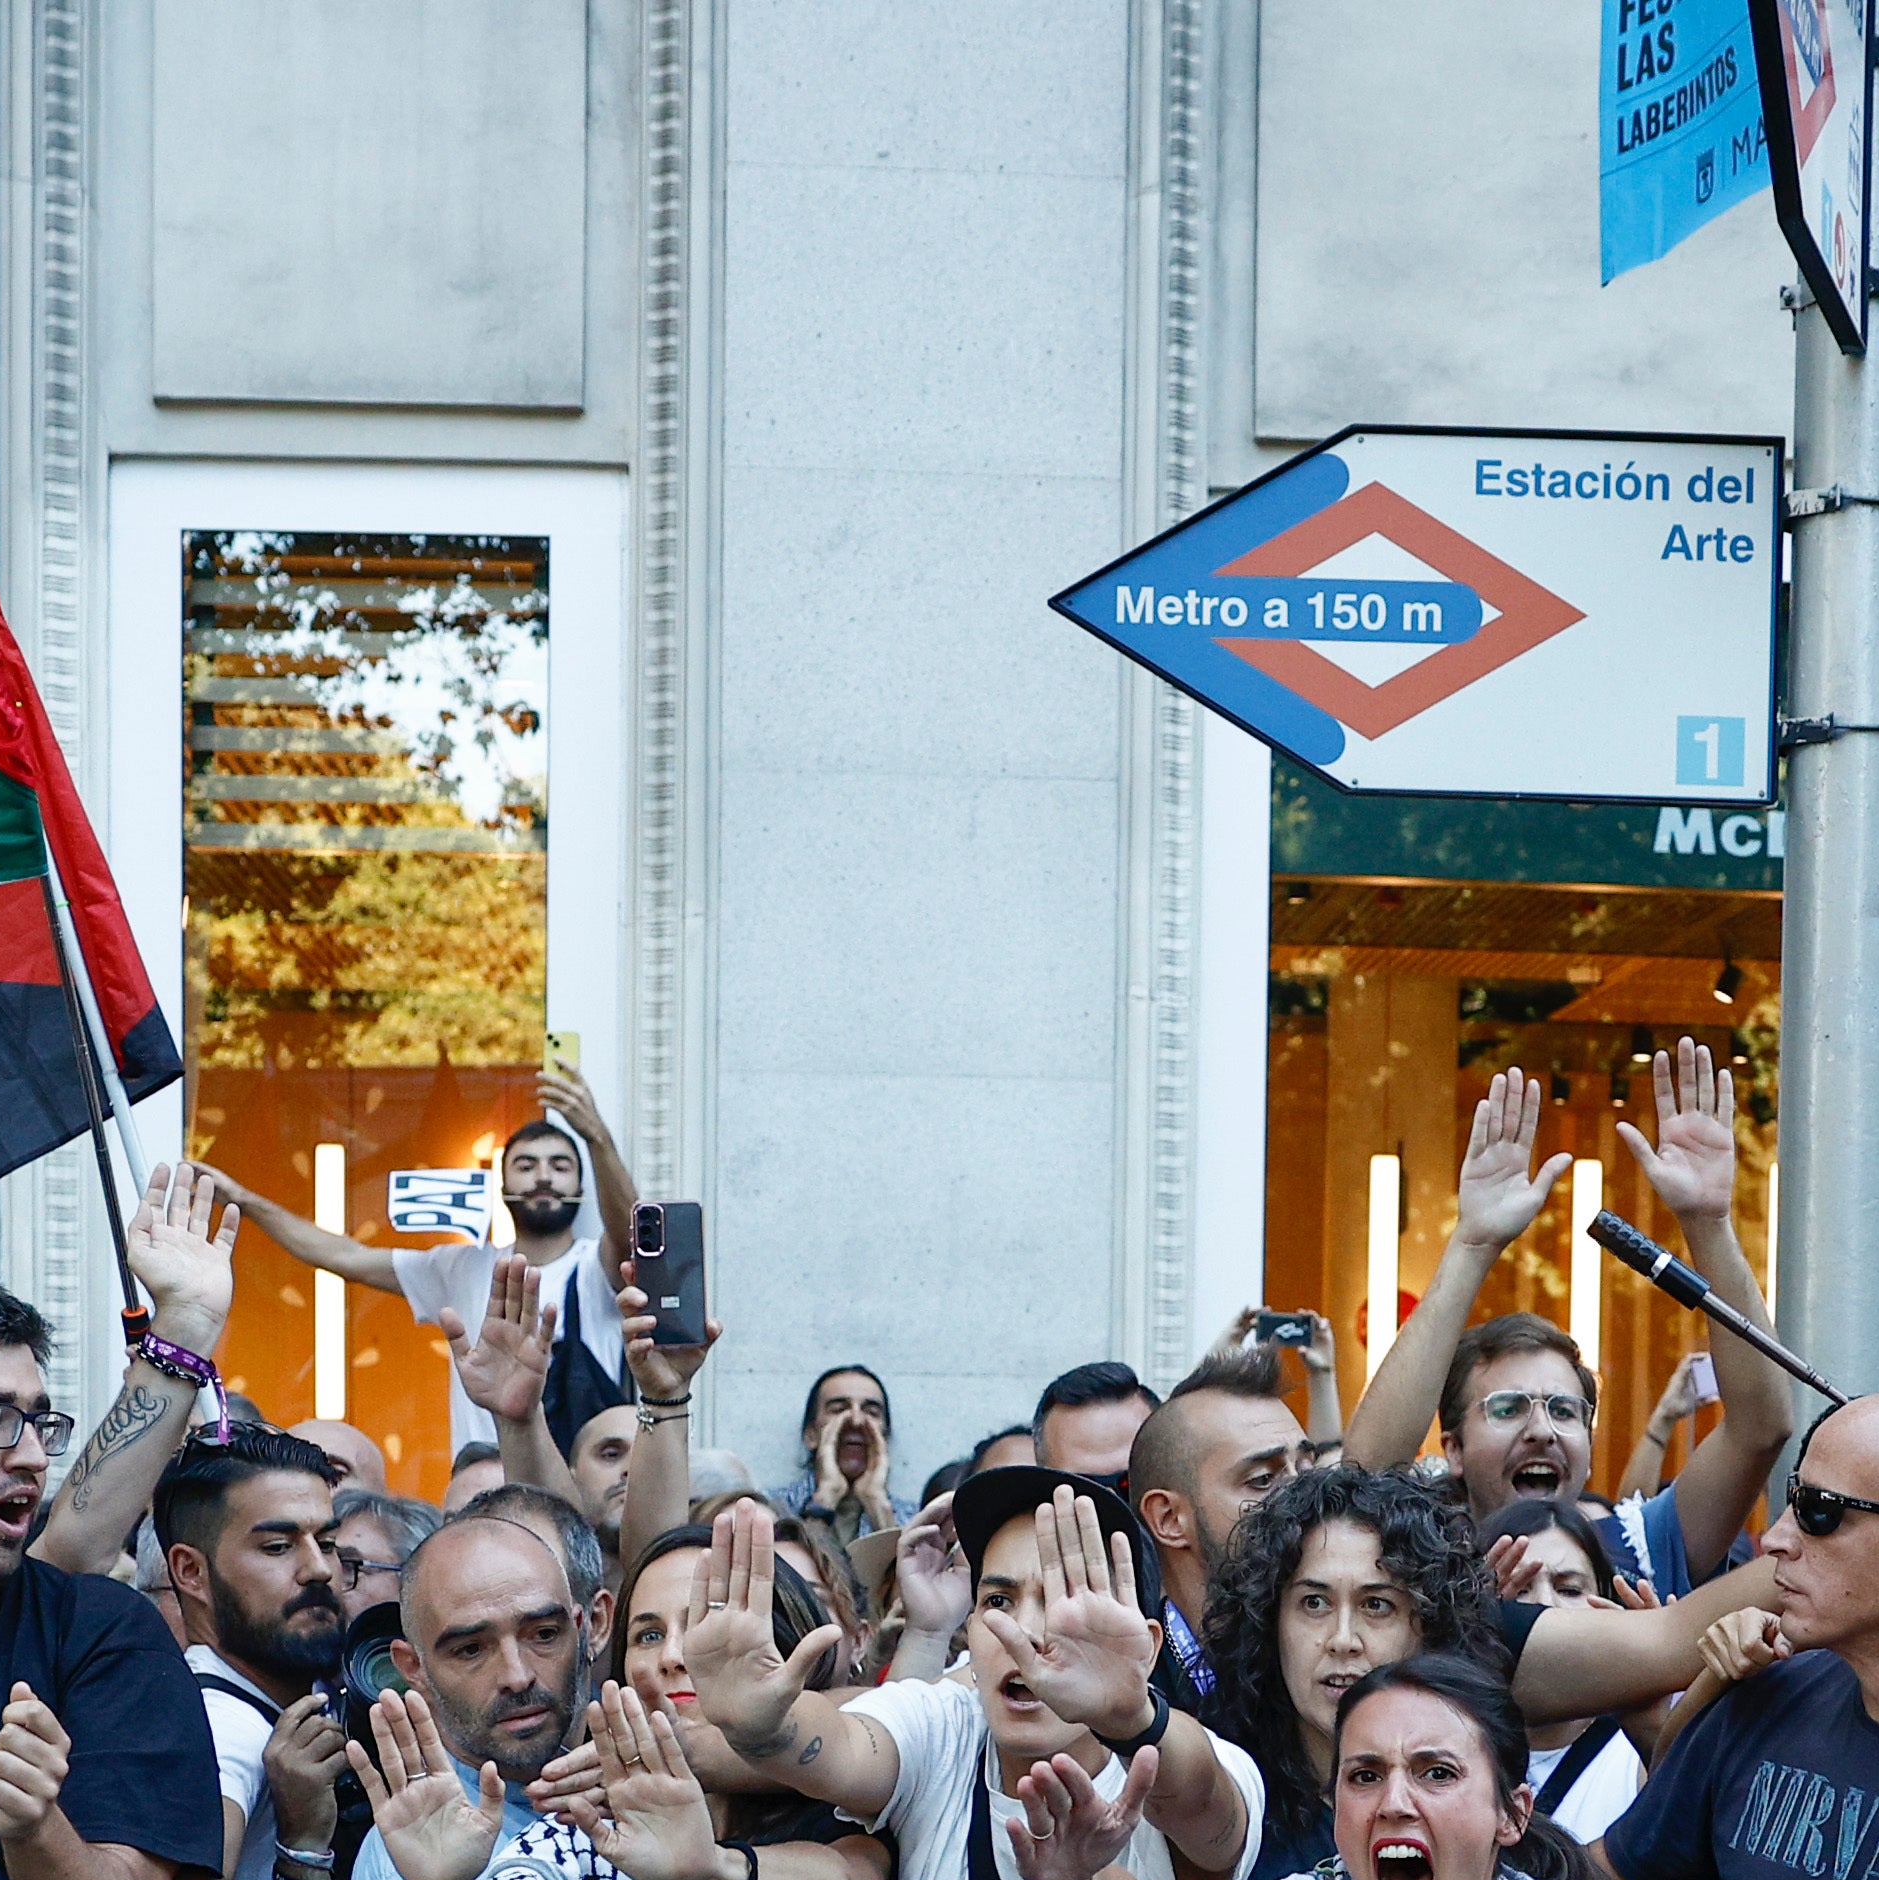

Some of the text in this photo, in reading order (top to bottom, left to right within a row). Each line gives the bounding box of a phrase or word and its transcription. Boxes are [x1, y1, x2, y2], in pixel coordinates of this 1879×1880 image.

[1617, 21, 1675, 93] LAS
[1617, 45, 1738, 154] LABERINTOS
[1474, 459, 1755, 505] Estación del
[1661, 525, 1754, 564] Arte
[1115, 585, 1443, 633] Metro a 150 m
[1693, 724, 1719, 775] 1
[393, 1173, 485, 1240] PAZ
